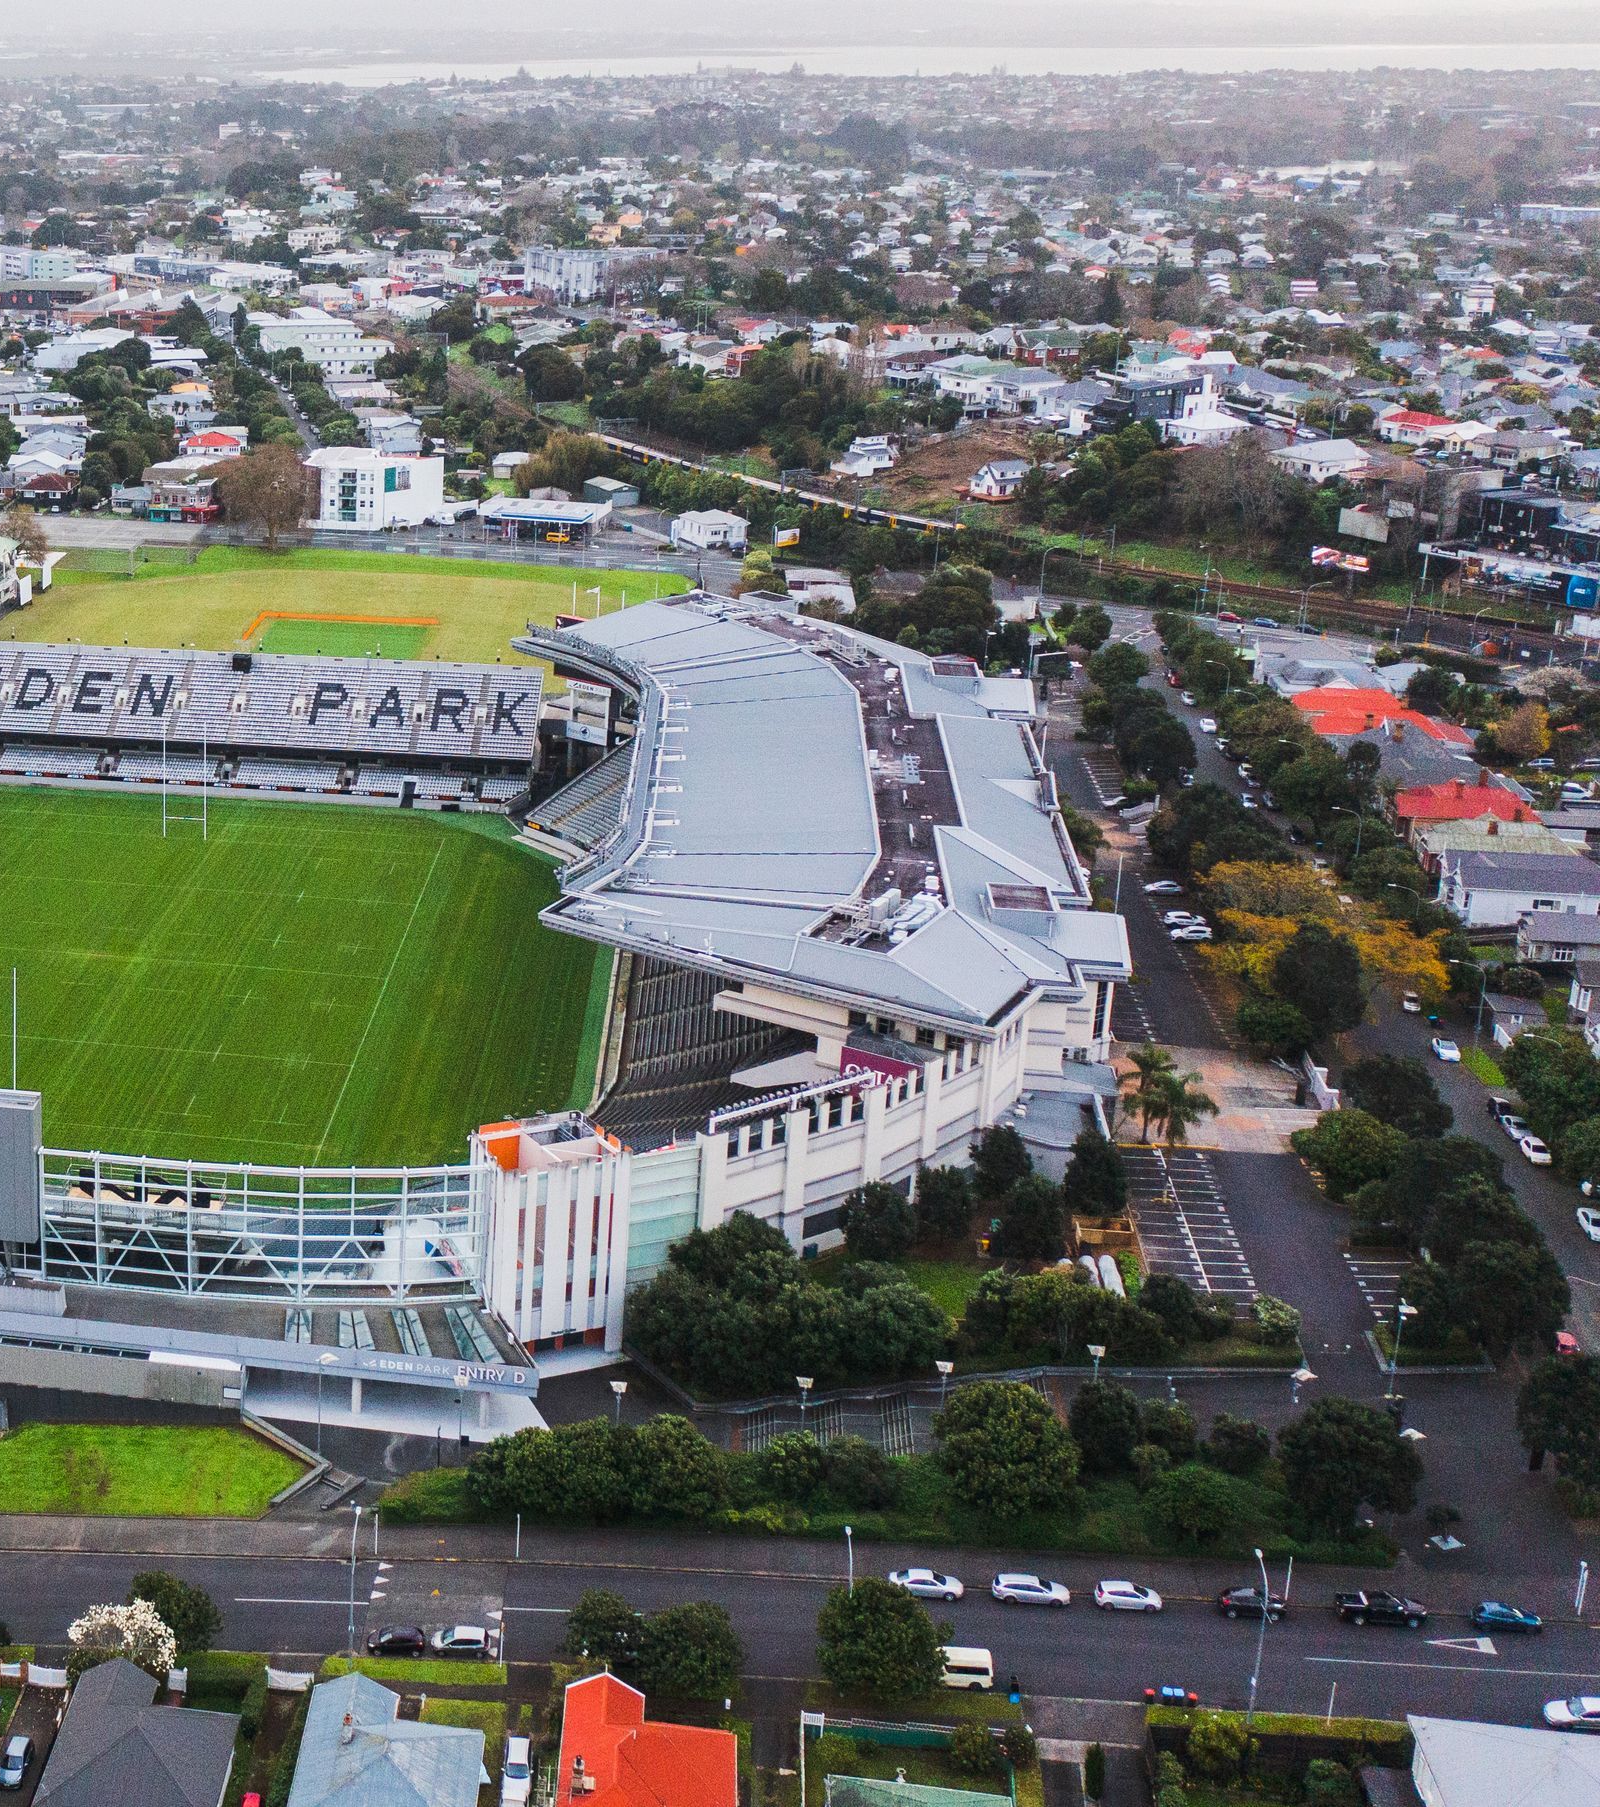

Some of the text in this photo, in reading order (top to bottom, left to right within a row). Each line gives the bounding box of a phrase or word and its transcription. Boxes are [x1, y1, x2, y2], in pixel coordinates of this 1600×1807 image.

[307, 681, 532, 736] PARK
[379, 1359, 526, 1384] EDEN PARK ENTRY D
